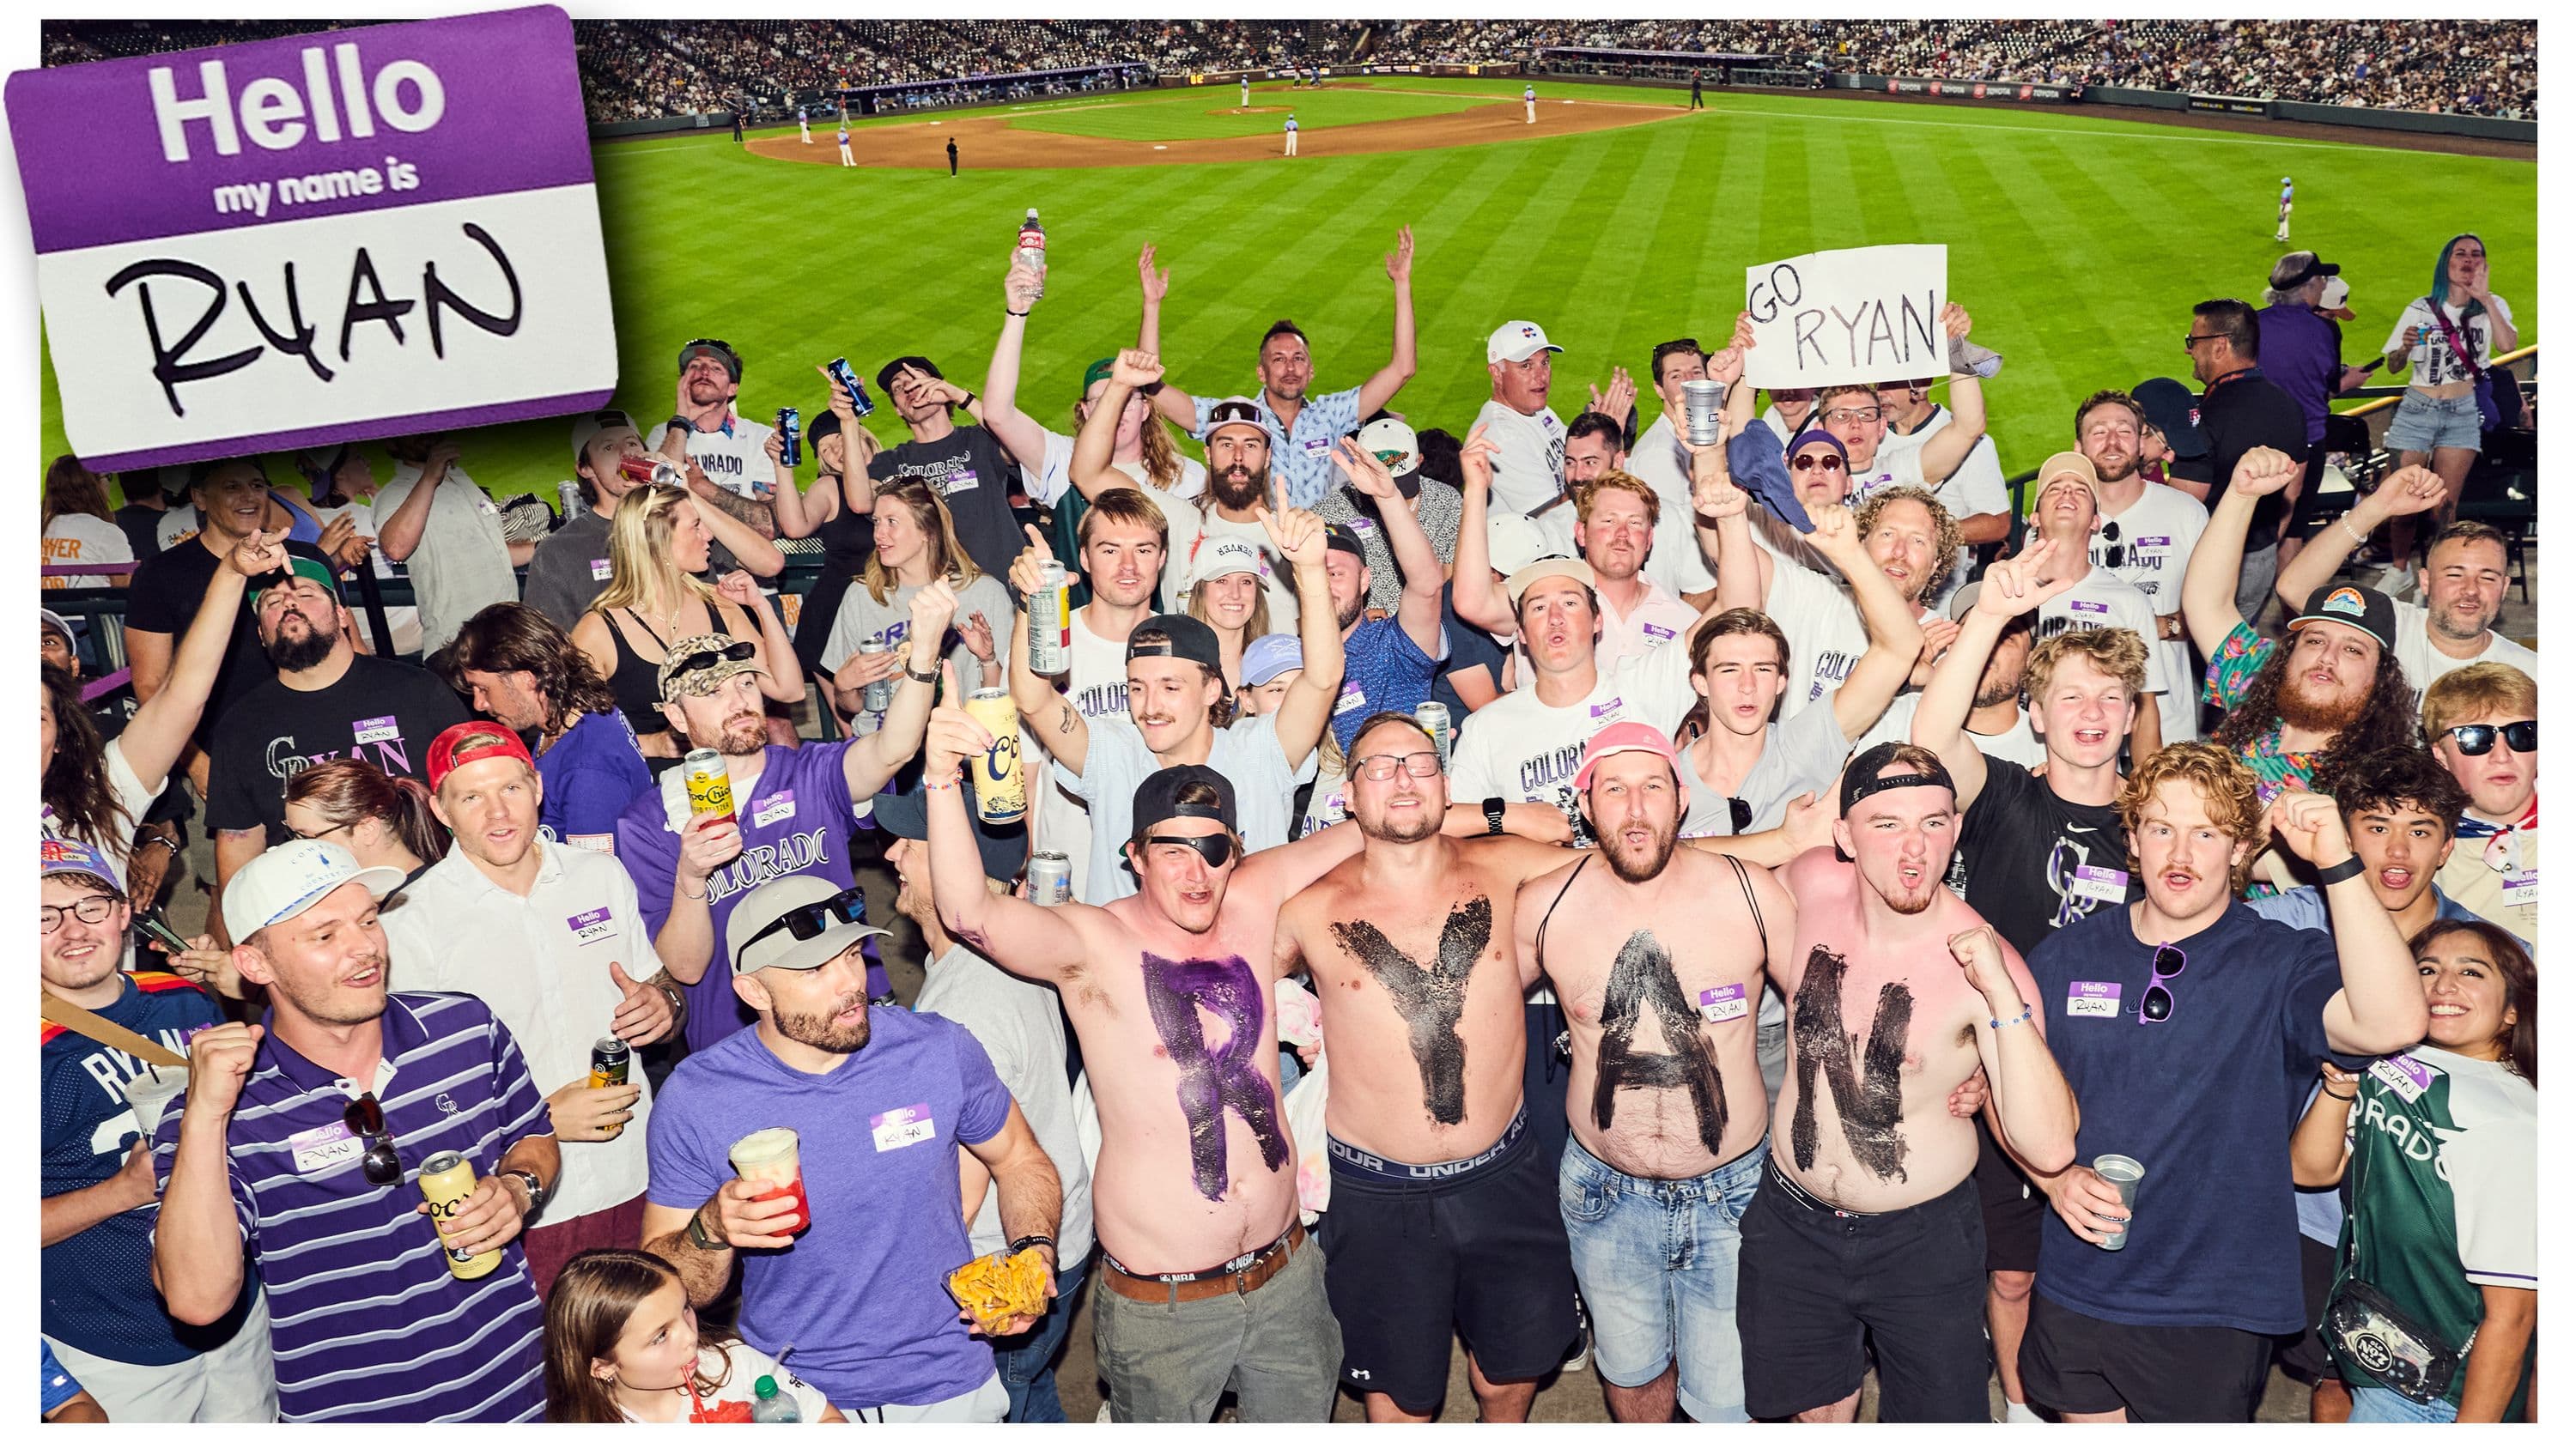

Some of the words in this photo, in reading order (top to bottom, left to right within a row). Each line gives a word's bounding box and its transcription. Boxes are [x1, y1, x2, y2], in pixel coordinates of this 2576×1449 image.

[1898, 83, 1922, 92] TOYOTA
[1941, 85, 1965, 94] TOYOTA
[1986, 87, 2011, 96] TOYOTA
[2032, 88, 2059, 99] TOYOTA
[1749, 264, 1802, 324] GO
[1794, 289, 1937, 371] RYAN
[2143, 536, 2164, 544] Hello
[1217, 543, 1254, 559] DENVER
[2080, 603, 2100, 611] Hello
[1650, 624, 1670, 636] Hello
[1597, 698, 1618, 712] Hello
[363, 718, 386, 729] Hello
[762, 793, 784, 808] Hello
[2088, 867, 2116, 880] Hello
[576, 912, 601, 925] Hello
[578, 924, 607, 939] RYAN
[1709, 986, 1735, 1000] Hello
[2080, 983, 2109, 993] Hello
[1710, 1000, 1741, 1016] RYAN
[81, 1028, 189, 1105] RYN
[2377, 1060, 2415, 1094] RYAN
[1409, 1138, 1507, 1179] UNDER
[1235, 1252, 1255, 1270] NBA
[1171, 1272, 1196, 1282] NBA
